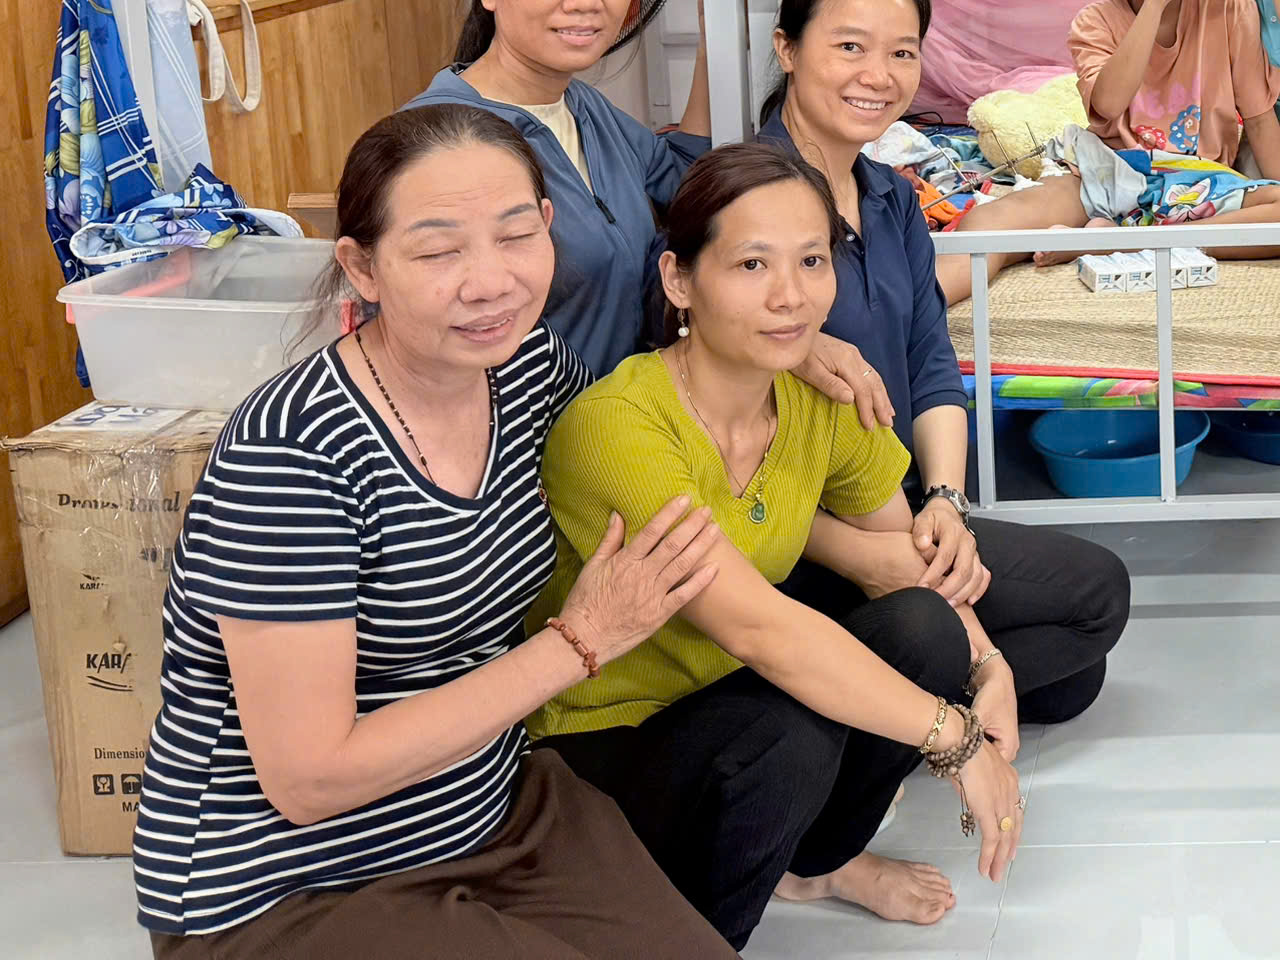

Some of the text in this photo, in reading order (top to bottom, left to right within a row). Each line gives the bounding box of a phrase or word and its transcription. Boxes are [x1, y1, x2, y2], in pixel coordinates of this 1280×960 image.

[86, 653, 132, 673] KAR
[94, 748, 145, 760] Dimensio
[122, 802, 139, 813] MA
